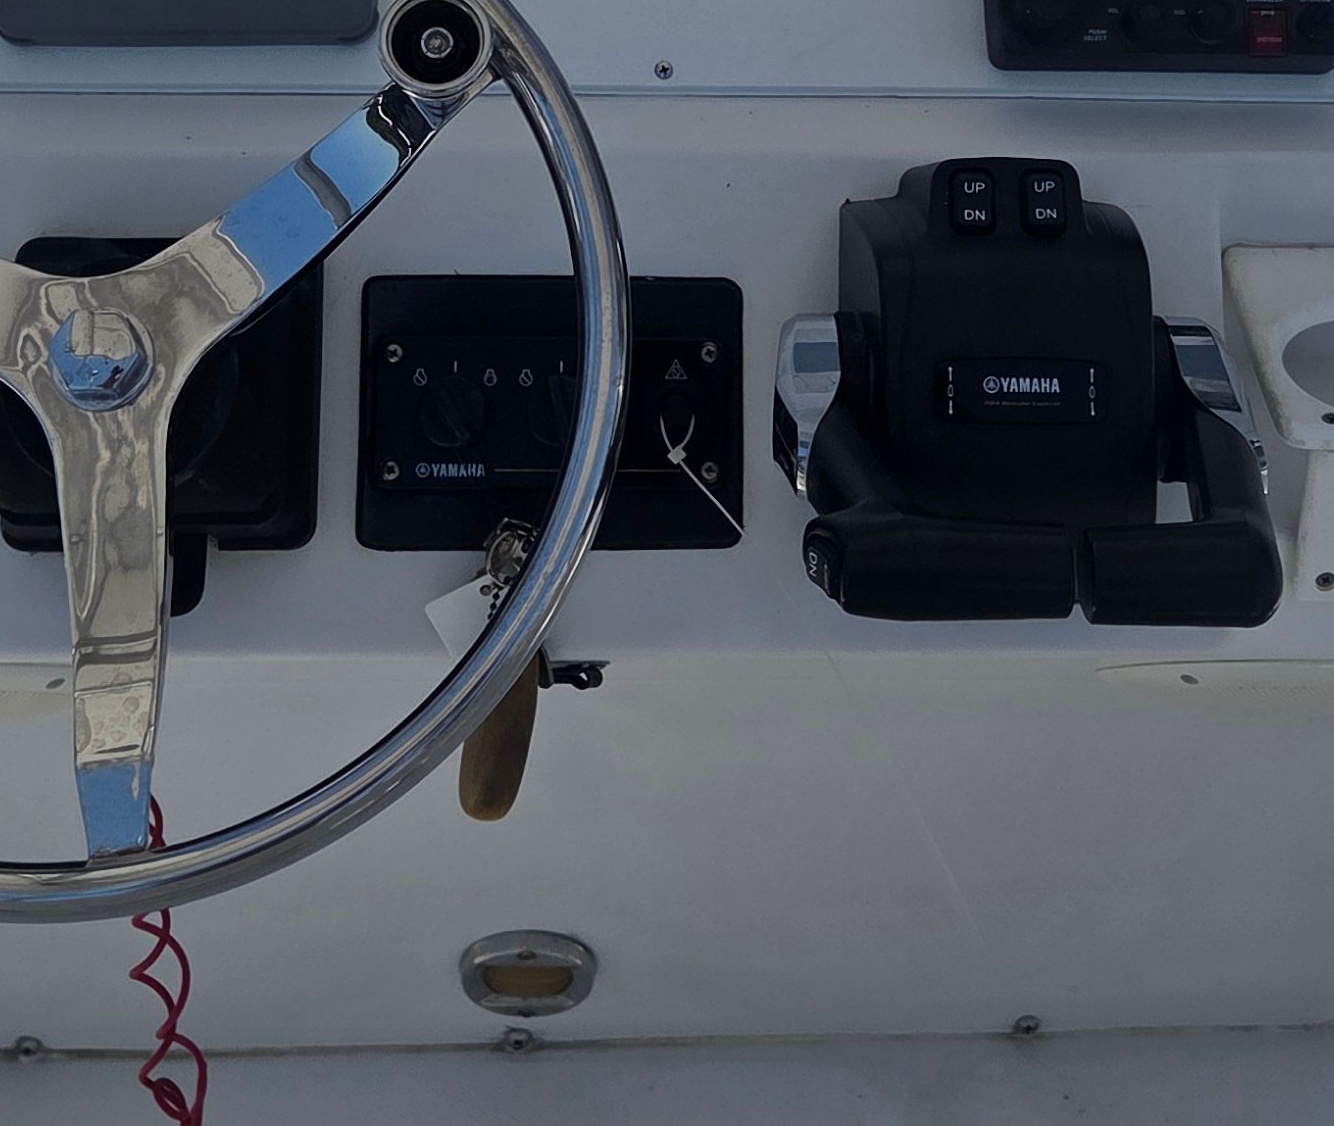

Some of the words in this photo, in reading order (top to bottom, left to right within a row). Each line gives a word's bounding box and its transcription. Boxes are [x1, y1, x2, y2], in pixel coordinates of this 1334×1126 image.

[963, 181, 986, 194] UP
[1033, 180, 1056, 193] UP
[963, 209, 986, 221] DN
[1034, 208, 1058, 220] DN
[1000, 377, 1061, 394] YAMAHA
[431, 462, 486, 478] YAMAHA
[808, 551, 818, 577] DN
